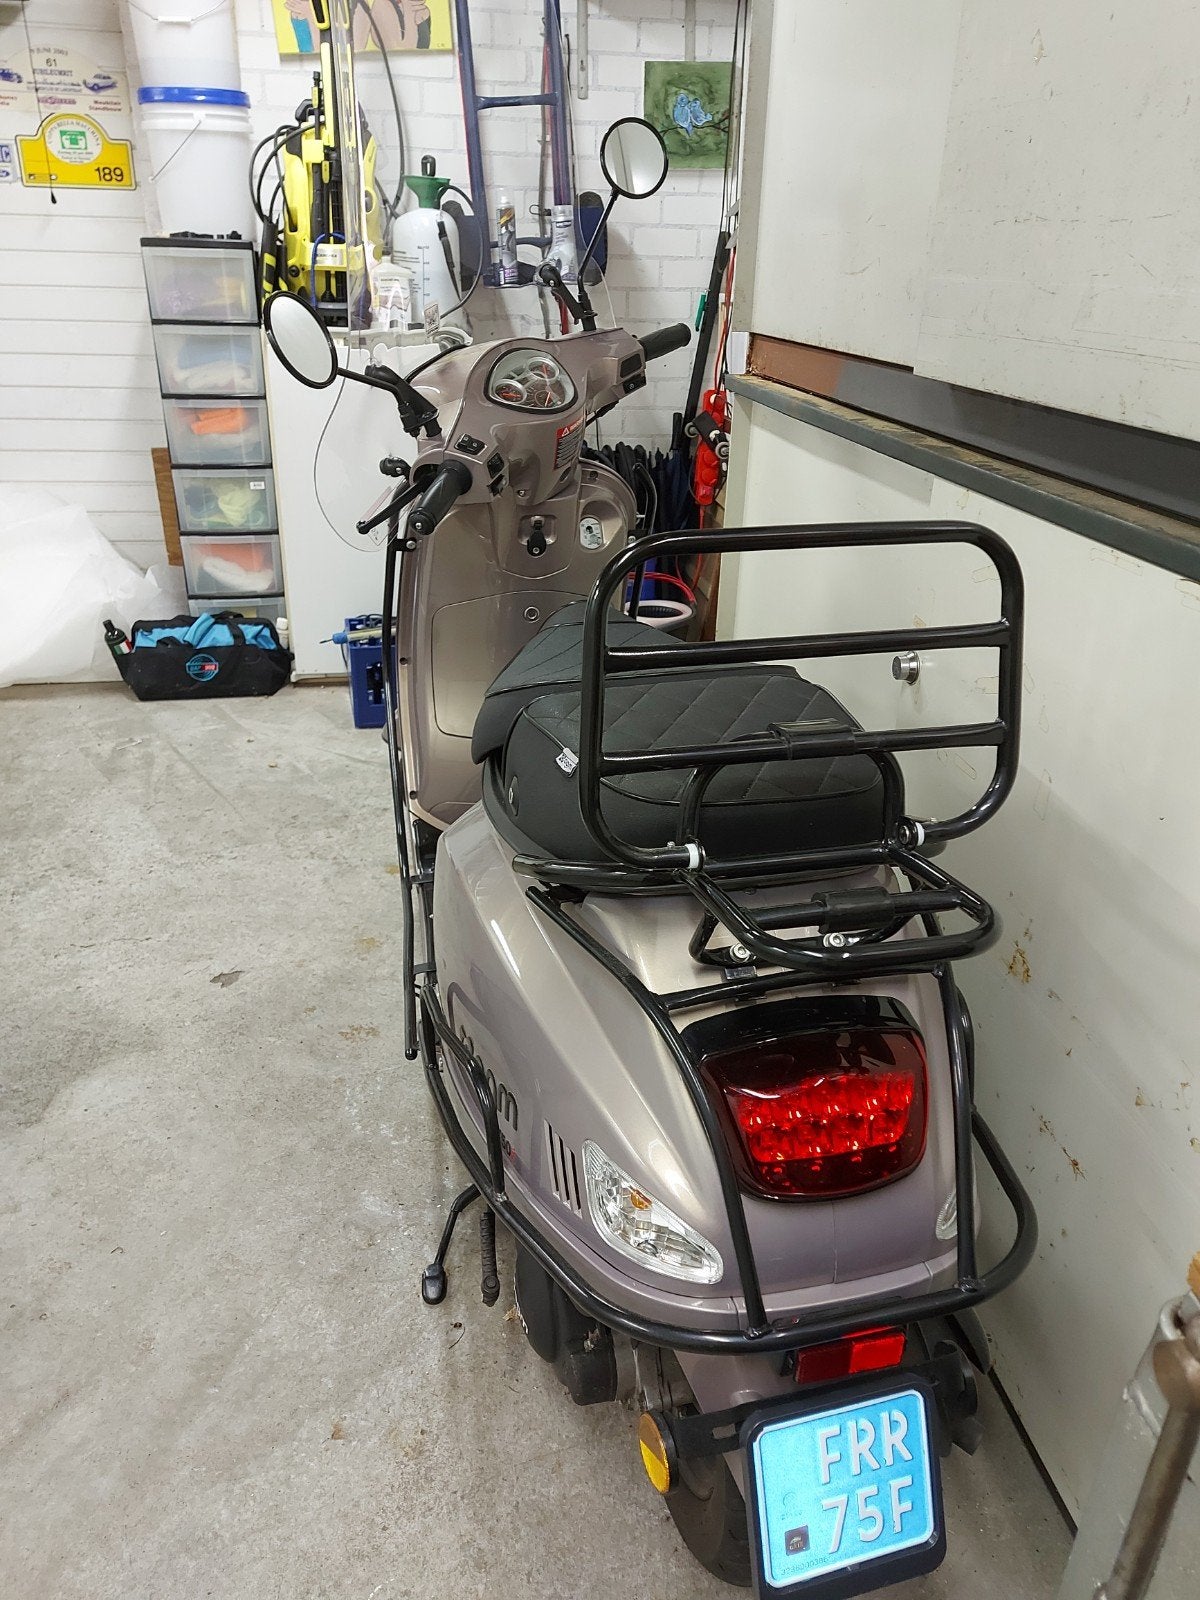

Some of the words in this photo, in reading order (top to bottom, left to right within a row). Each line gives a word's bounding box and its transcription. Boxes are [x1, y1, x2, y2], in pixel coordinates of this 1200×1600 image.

[46, 57, 58, 67] 61
[95, 166, 124, 182] 189
[818, 1410, 913, 1485] FRR
[821, 1474, 913, 1554] 75F
